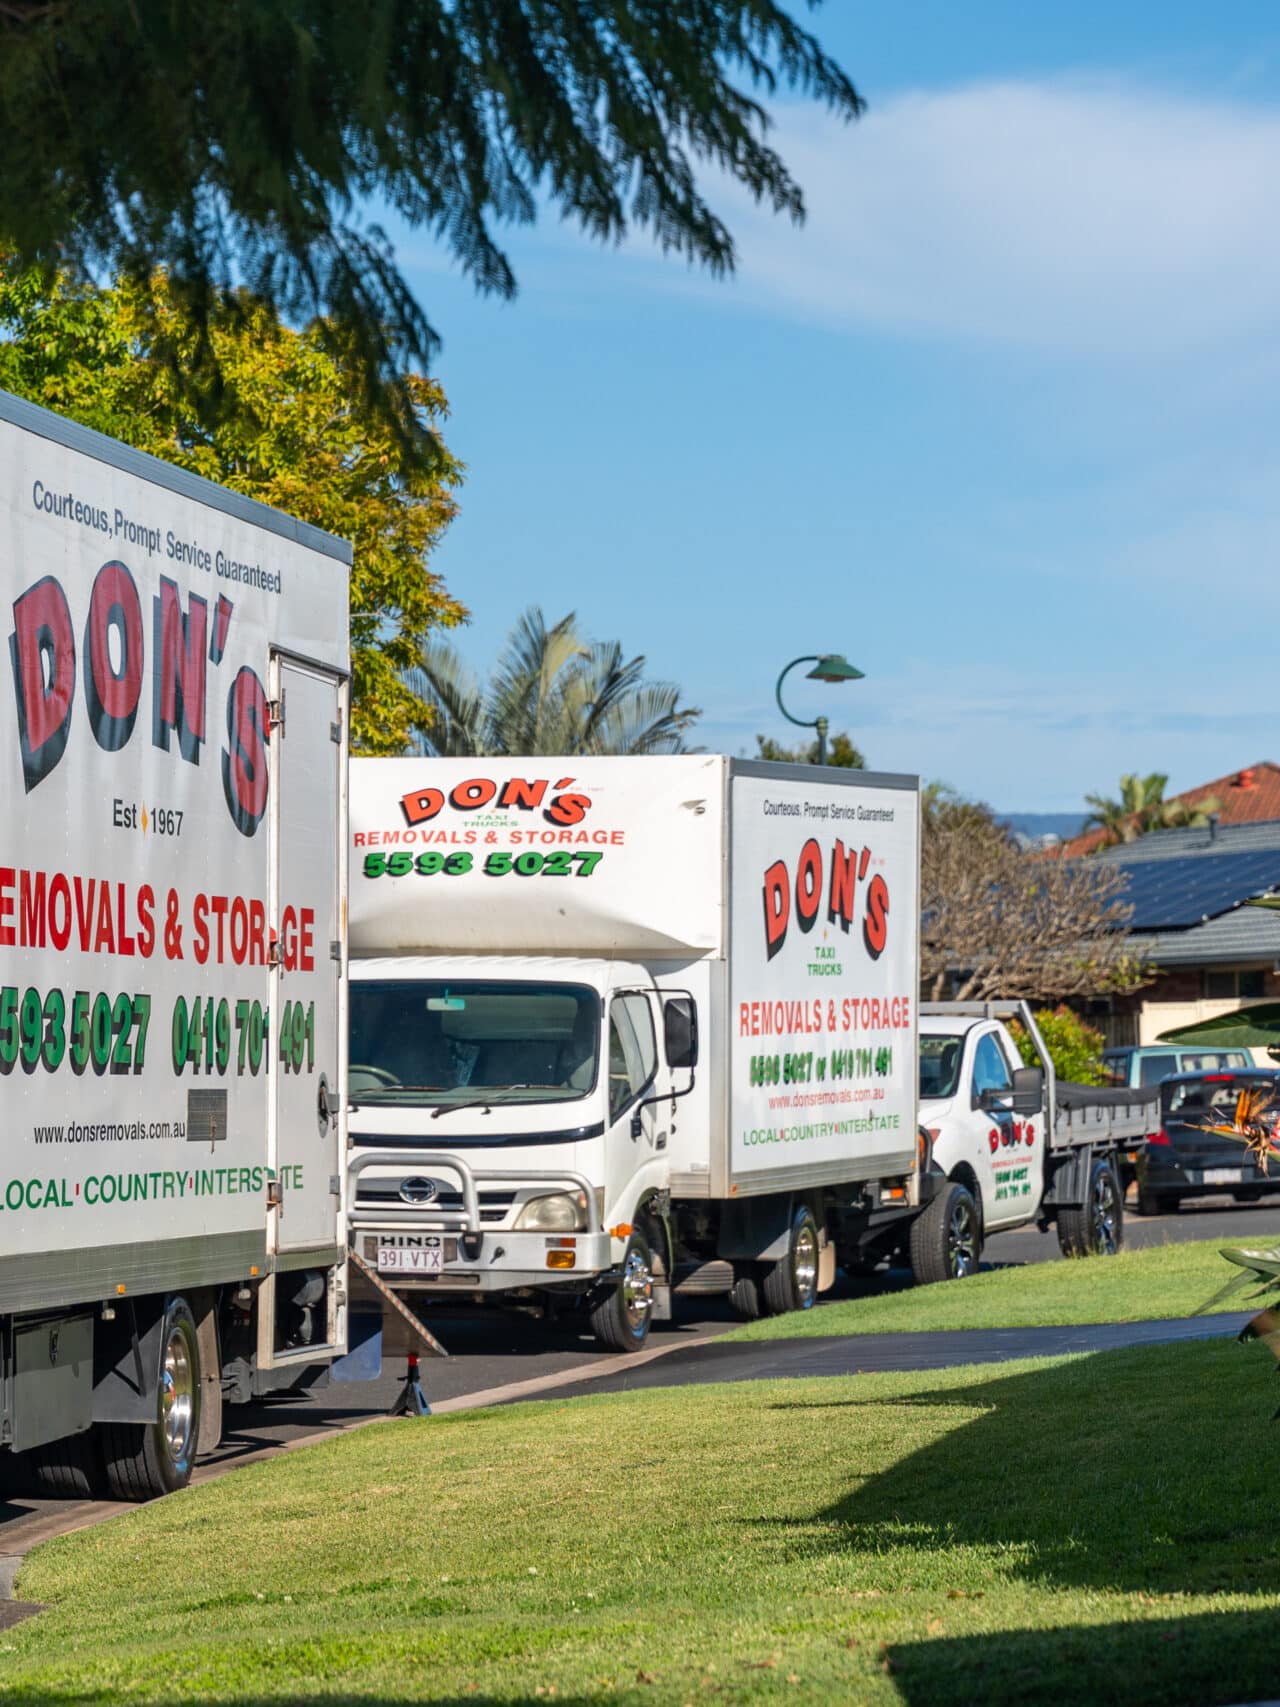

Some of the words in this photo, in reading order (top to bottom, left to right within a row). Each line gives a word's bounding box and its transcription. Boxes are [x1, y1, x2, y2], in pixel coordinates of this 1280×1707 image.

[33, 480, 113, 539] Courteous,
[114, 509, 161, 557] Prompt
[166, 531, 211, 572] Service
[215, 550, 281, 594] Guaranteed
[8, 560, 271, 837] DON'S
[113, 799, 137, 829] Est
[150, 807, 183, 836] 1967
[399, 777, 592, 827] DON'S
[831, 804, 855, 819] Service
[857, 805, 894, 821] Guaranteed
[354, 830, 477, 847] REMOVALS
[484, 830, 498, 844] &
[510, 830, 625, 845] STORAGE
[363, 852, 473, 879] 5593
[483, 851, 603, 877] 5027
[762, 838, 889, 962] DON'S
[164, 887, 184, 960] &
[807, 964, 842, 976] TRUCKS
[815, 947, 835, 959] TAXI
[70, 991, 151, 1076] 5027
[172, 995, 230, 1076] 0419
[279, 1000, 314, 1075] 491
[740, 999, 822, 1037] REMOVALS
[827, 999, 837, 1032] &
[842, 997, 910, 1031] STORAGE
[34, 1121, 185, 1144] www.donsremovals.com.au
[784, 1122, 833, 1142] COUNTRY
[838, 1114, 900, 1135] INTERSTATE
[84, 1170, 189, 1204] COUNTRY
[195, 1165, 304, 1196] INTERSTE
[381, 1236, 440, 1247] HINO
